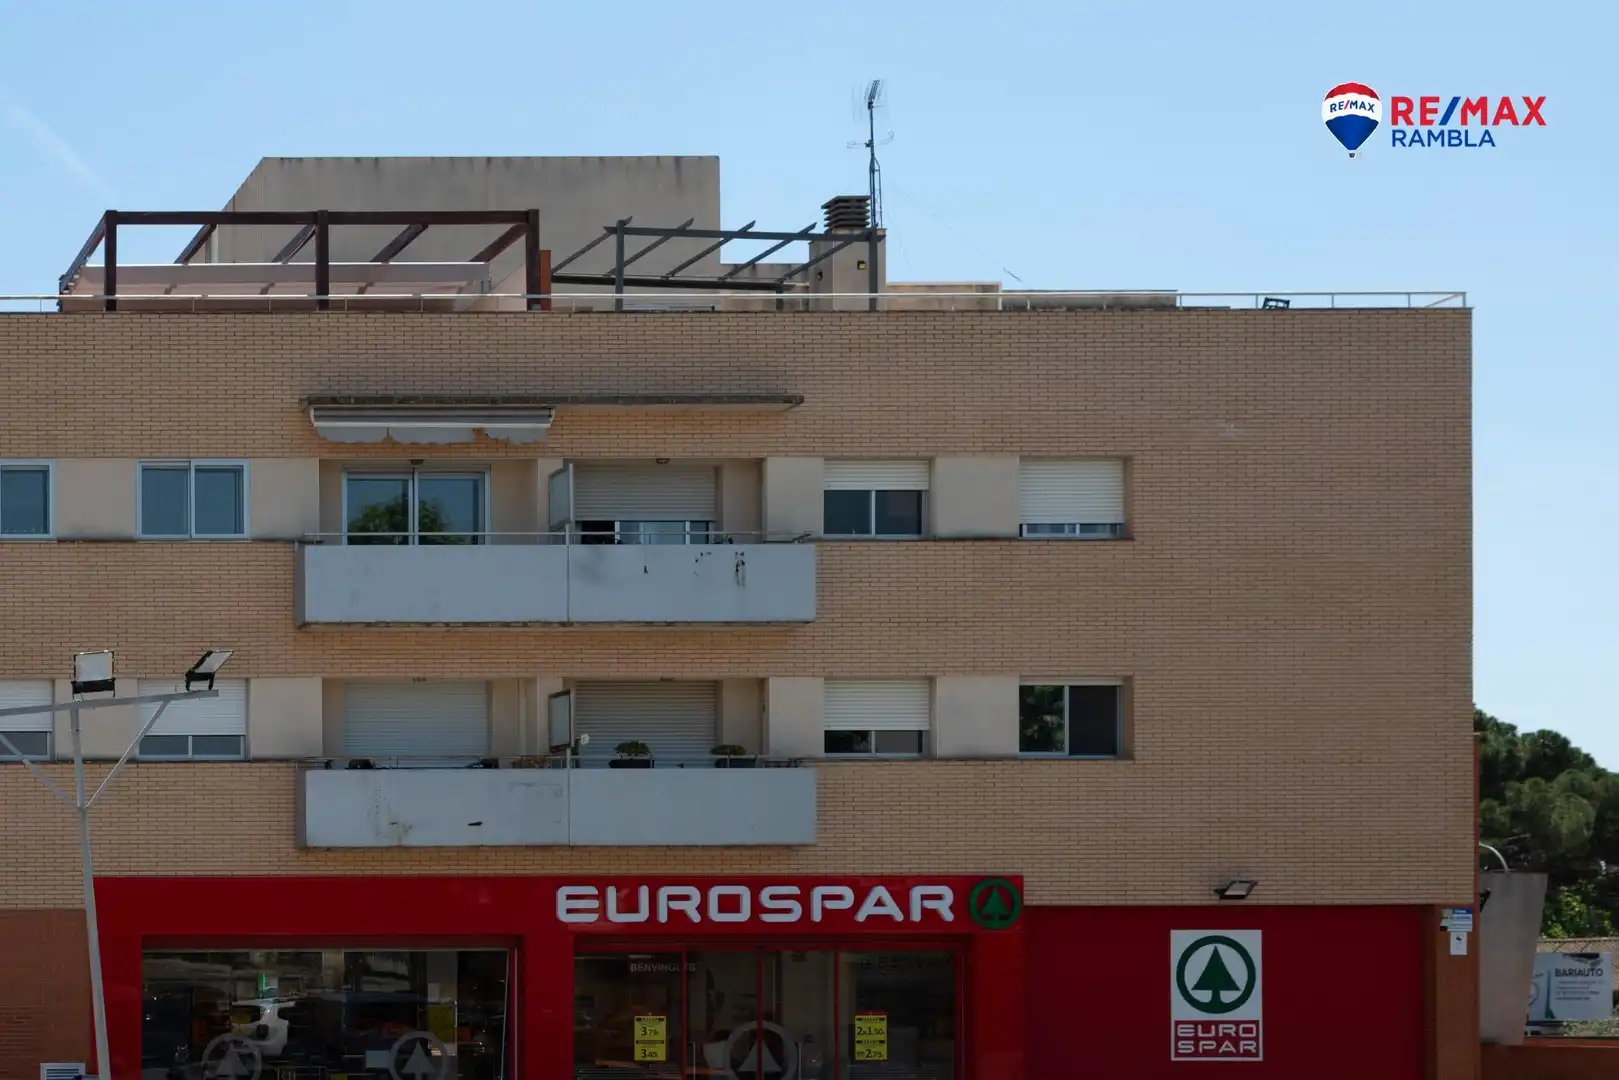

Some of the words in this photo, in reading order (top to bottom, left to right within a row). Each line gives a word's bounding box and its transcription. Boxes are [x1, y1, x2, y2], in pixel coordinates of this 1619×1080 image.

[556, 885, 954, 923] EUROSPAR
[1555, 967, 1603, 977] BARIAUTO
[1177, 1023, 1256, 1037] EURO
[1177, 1040, 1256, 1053] SPAR
